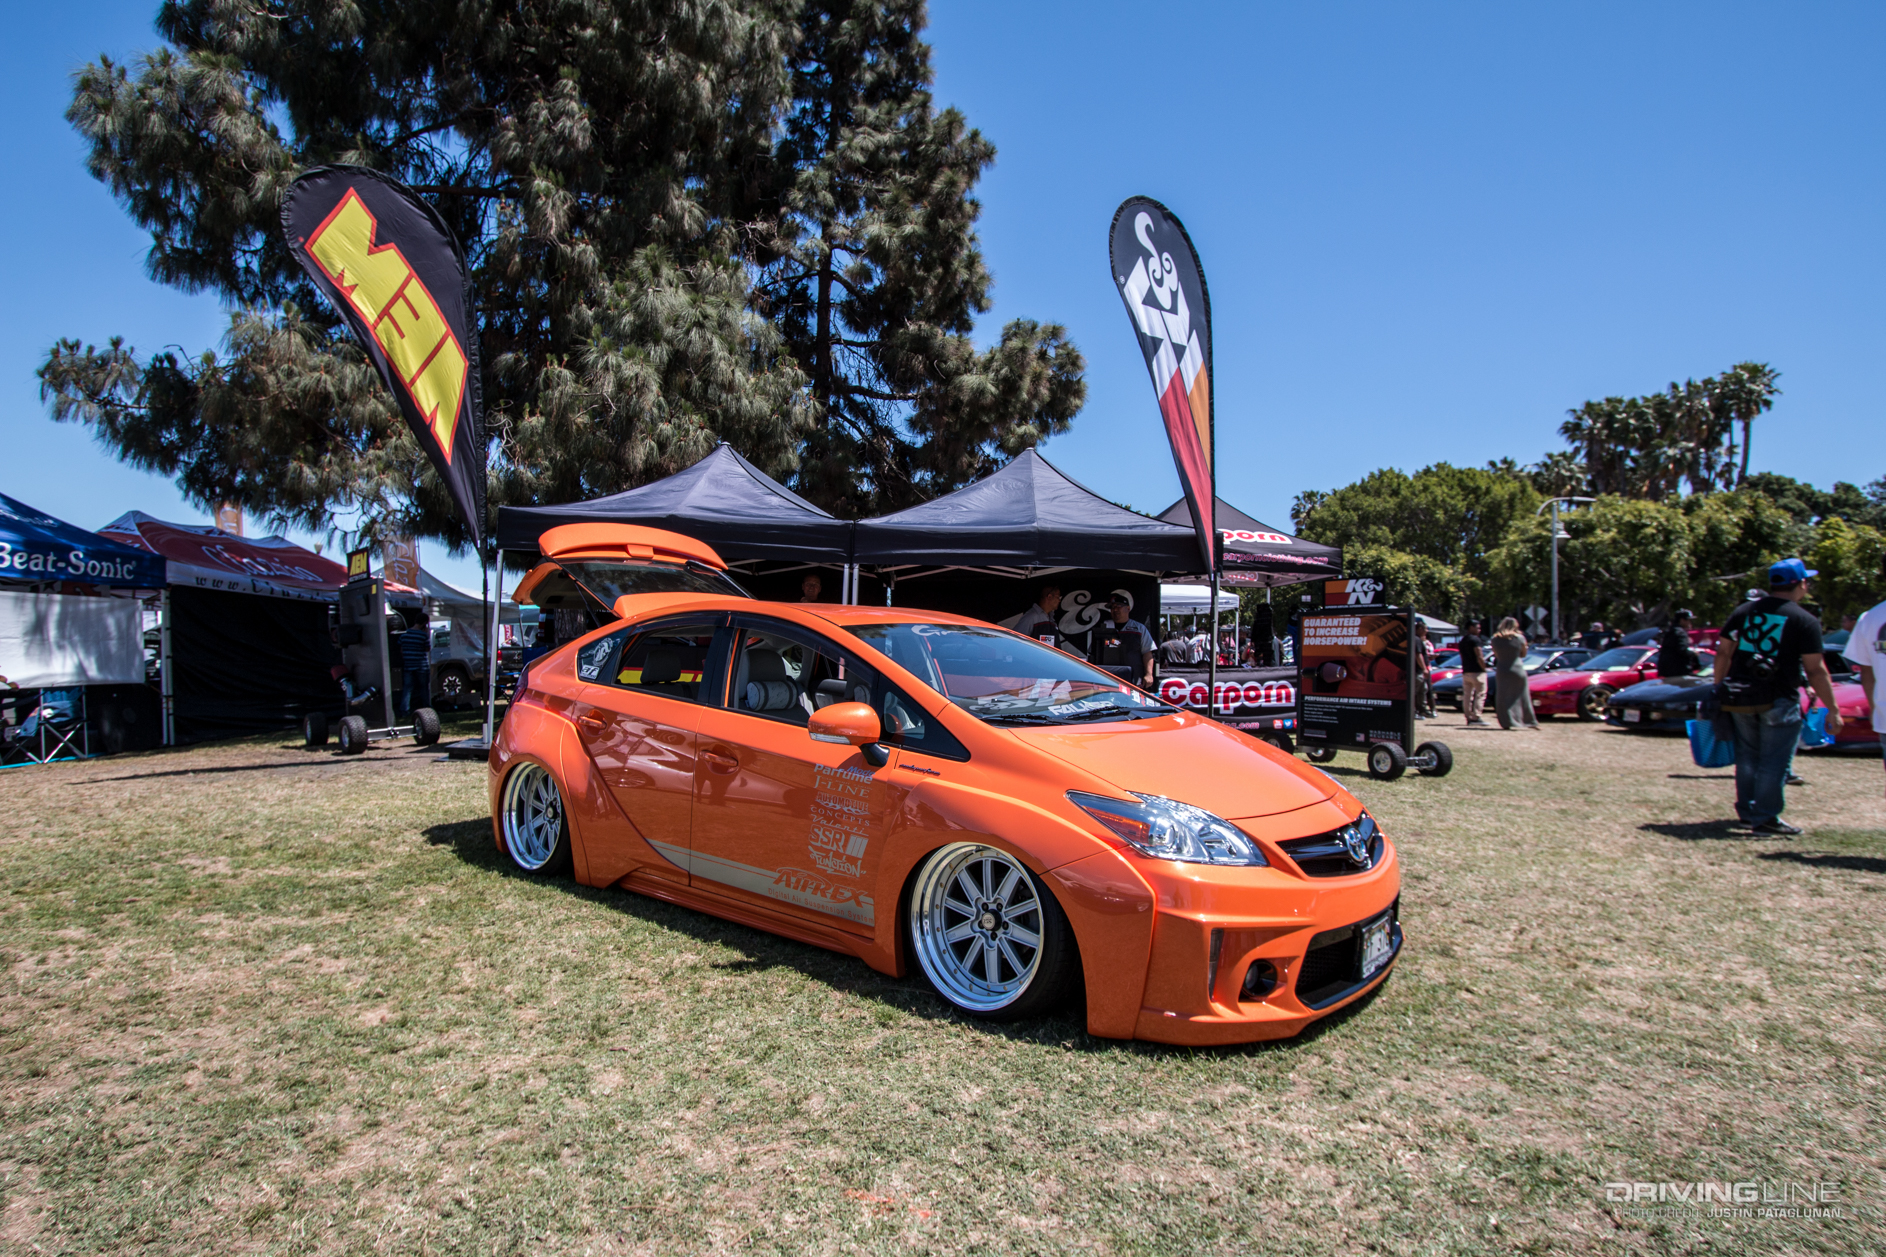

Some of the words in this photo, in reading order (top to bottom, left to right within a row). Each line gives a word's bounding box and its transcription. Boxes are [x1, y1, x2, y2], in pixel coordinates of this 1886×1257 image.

[1304, 617, 1361, 627] GUARANTEED
[1304, 628, 1315, 636] TO
[1316, 627, 1360, 636] INCREASE
[1303, 636, 1368, 645] HORSEPOWER!
[1158, 678, 1296, 714] Carporn
[1304, 695, 1339, 703] PERFORMANCE
[813, 763, 873, 784] Parfume
[813, 775, 870, 798] J-LINE
[815, 791, 869, 812] AUTOMOTIVE
[810, 806, 870, 826] CONCEPTS
[810, 813, 869, 837] Valenti
[808, 824, 845, 853] SSR
[768, 887, 790, 902] Digital
[792, 895, 801, 904] Air
[804, 897, 845, 916] Suspension
[847, 910, 874, 924] System
